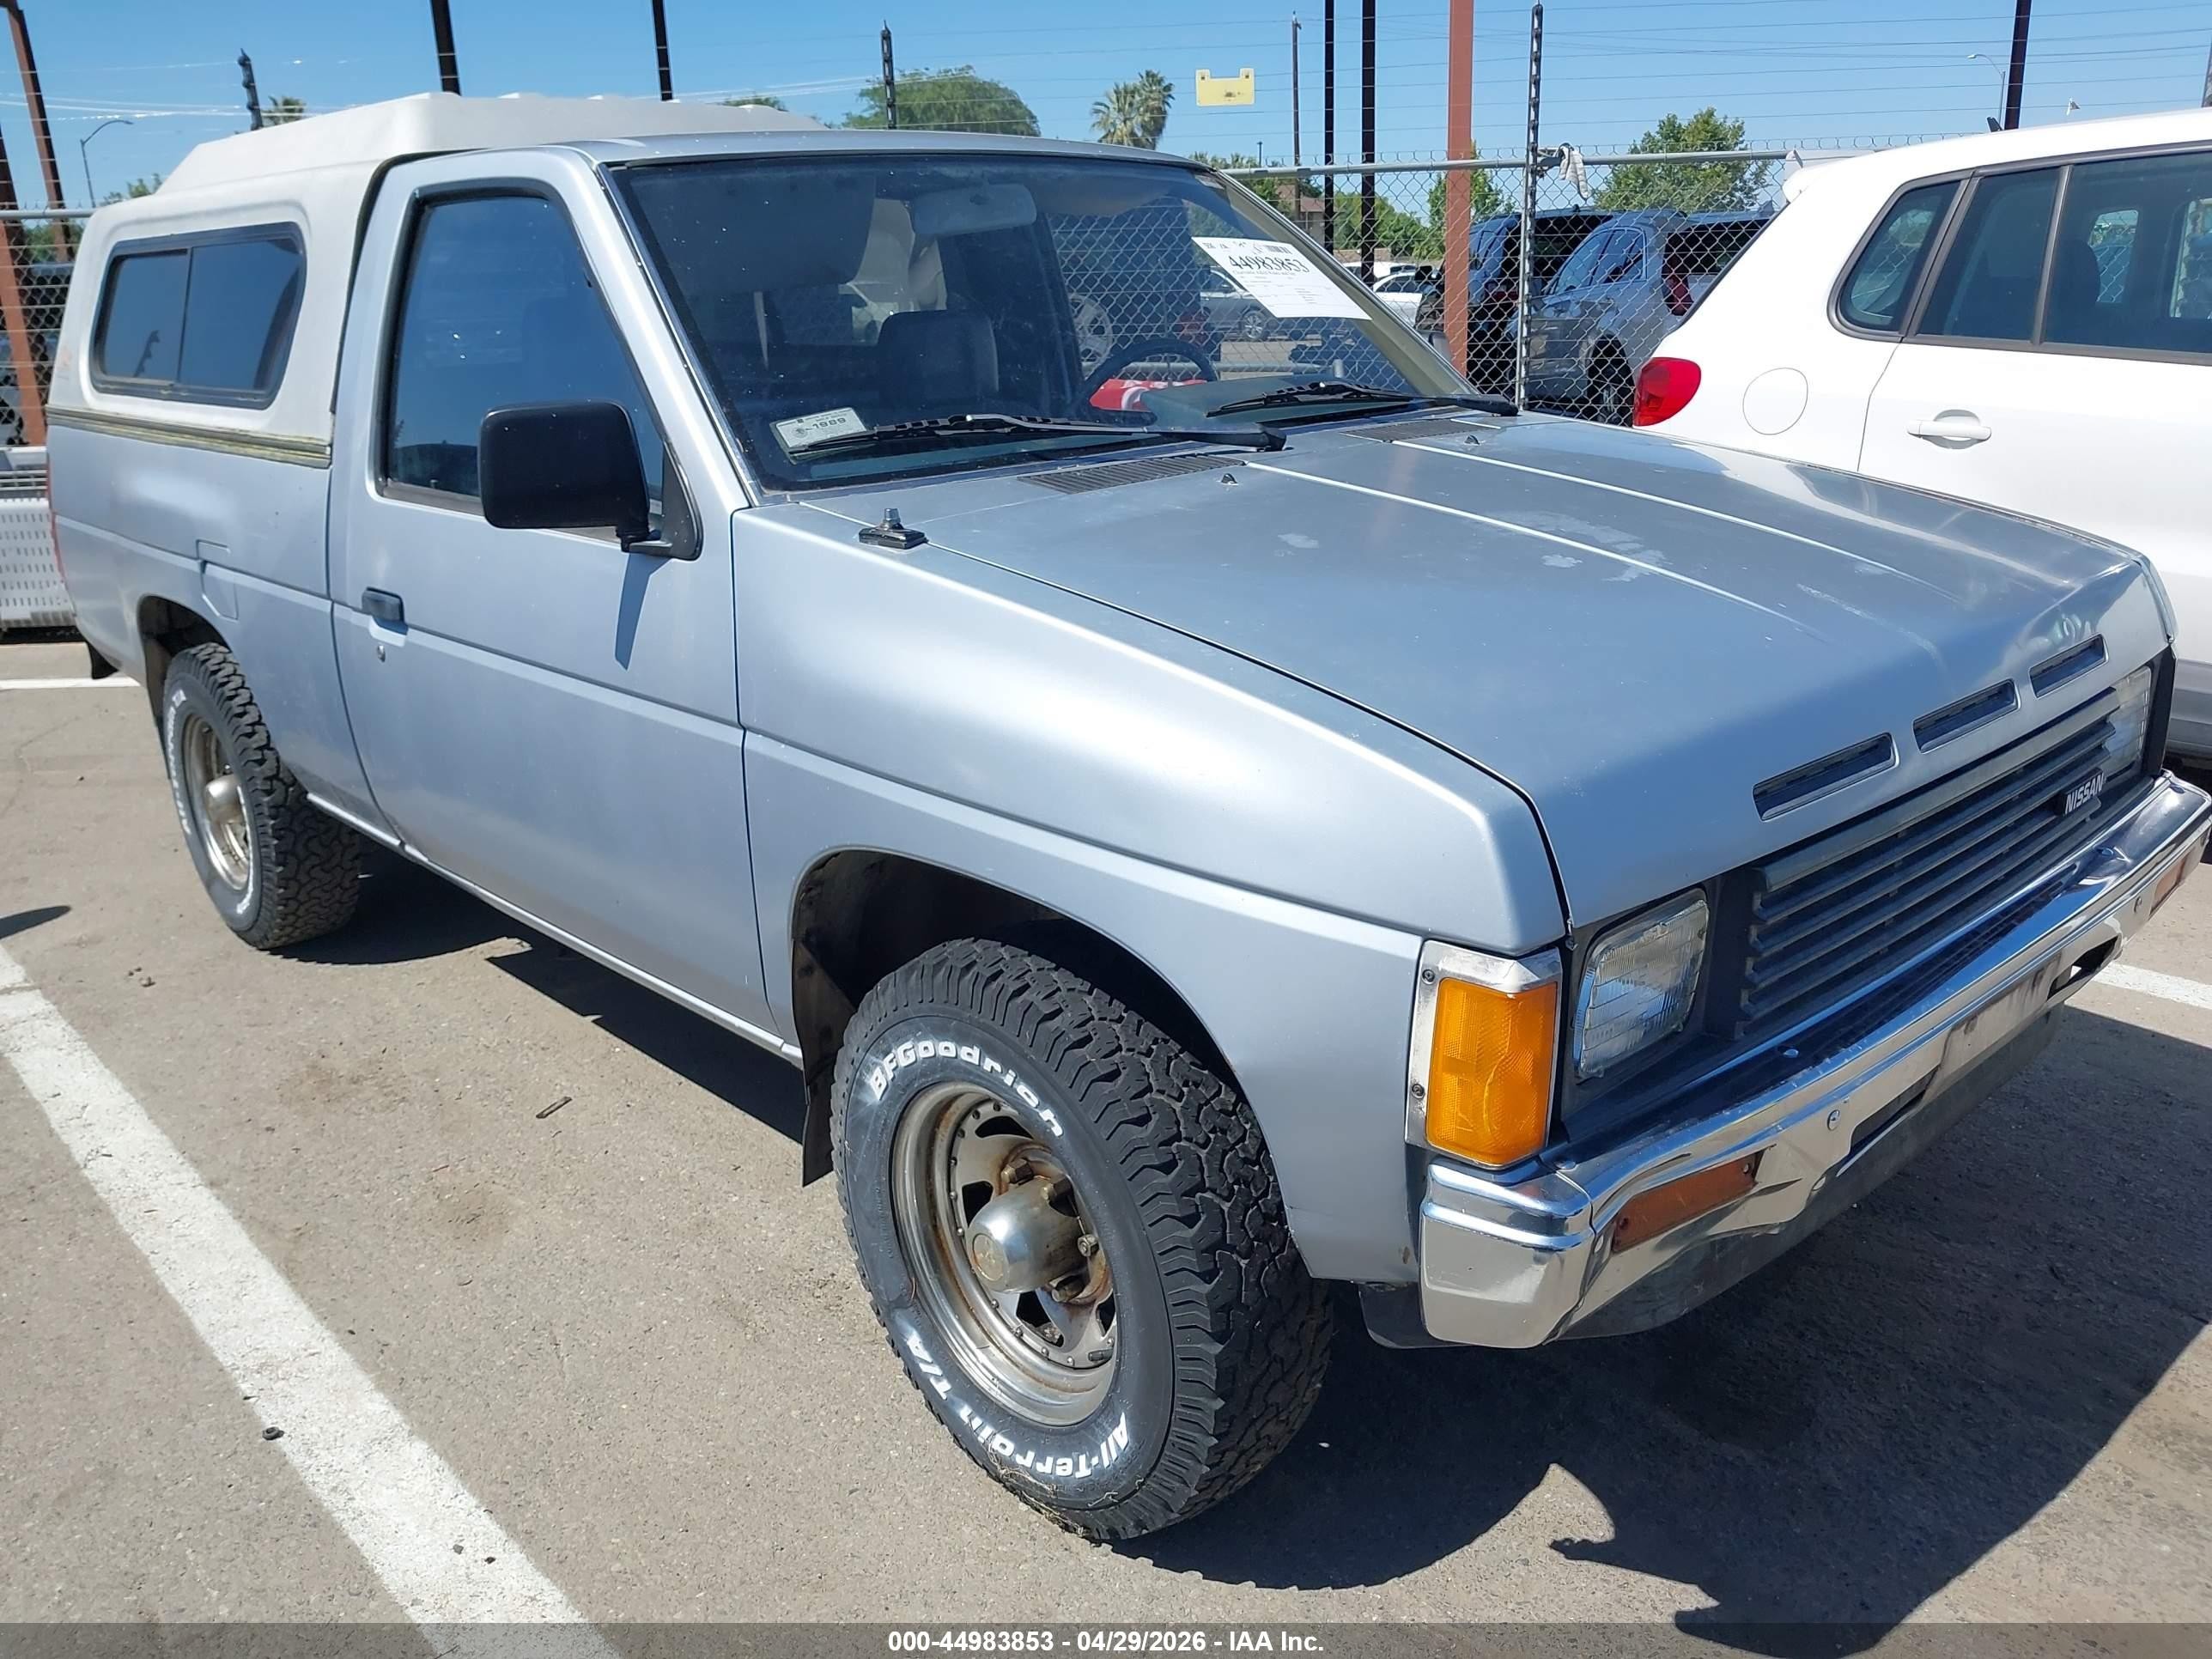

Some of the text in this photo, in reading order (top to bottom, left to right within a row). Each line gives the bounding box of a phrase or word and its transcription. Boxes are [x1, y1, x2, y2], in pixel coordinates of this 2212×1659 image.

[1229, 255, 1310, 273] 44983853
[2064, 772, 2105, 815] NISSAN
[868, 1040, 1064, 1137] BFGoodrich
[906, 1331, 952, 1401] T/A
